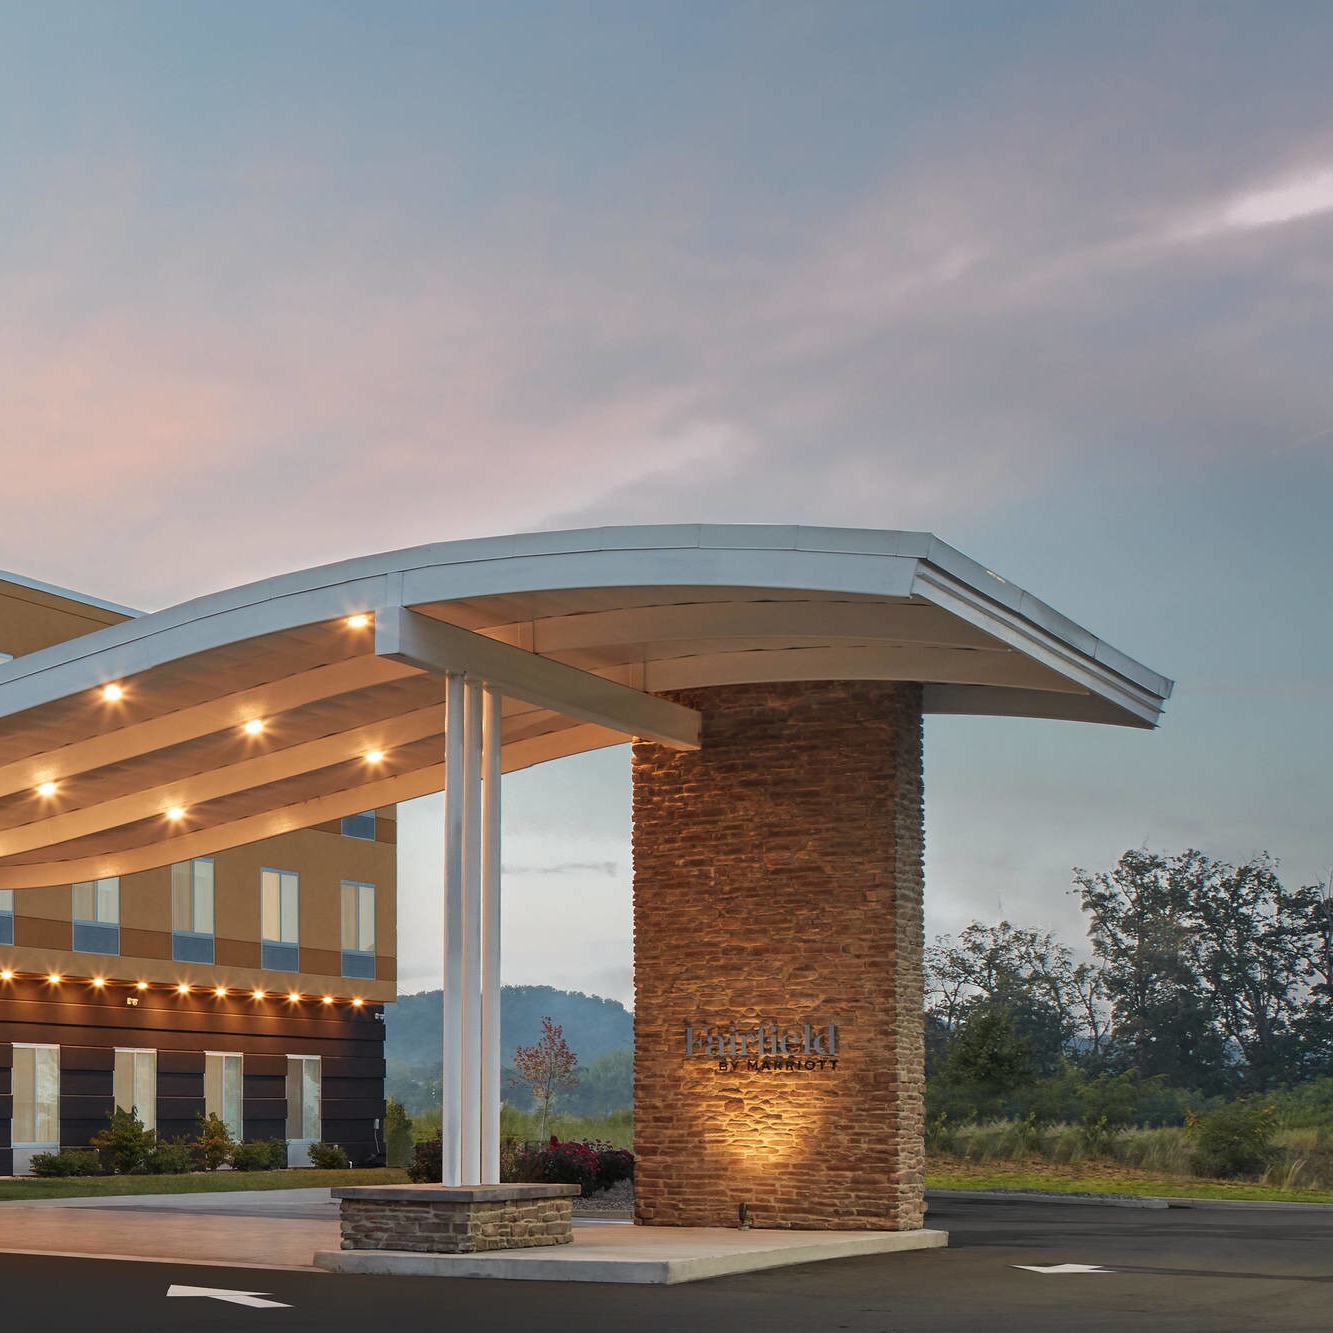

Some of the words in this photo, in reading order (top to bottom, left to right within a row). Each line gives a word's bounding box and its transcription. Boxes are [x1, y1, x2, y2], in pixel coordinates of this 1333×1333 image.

[685, 1024, 838, 1057] Fairfield
[719, 1062, 739, 1071] BY
[748, 1060, 839, 1071] MARRIOTT
